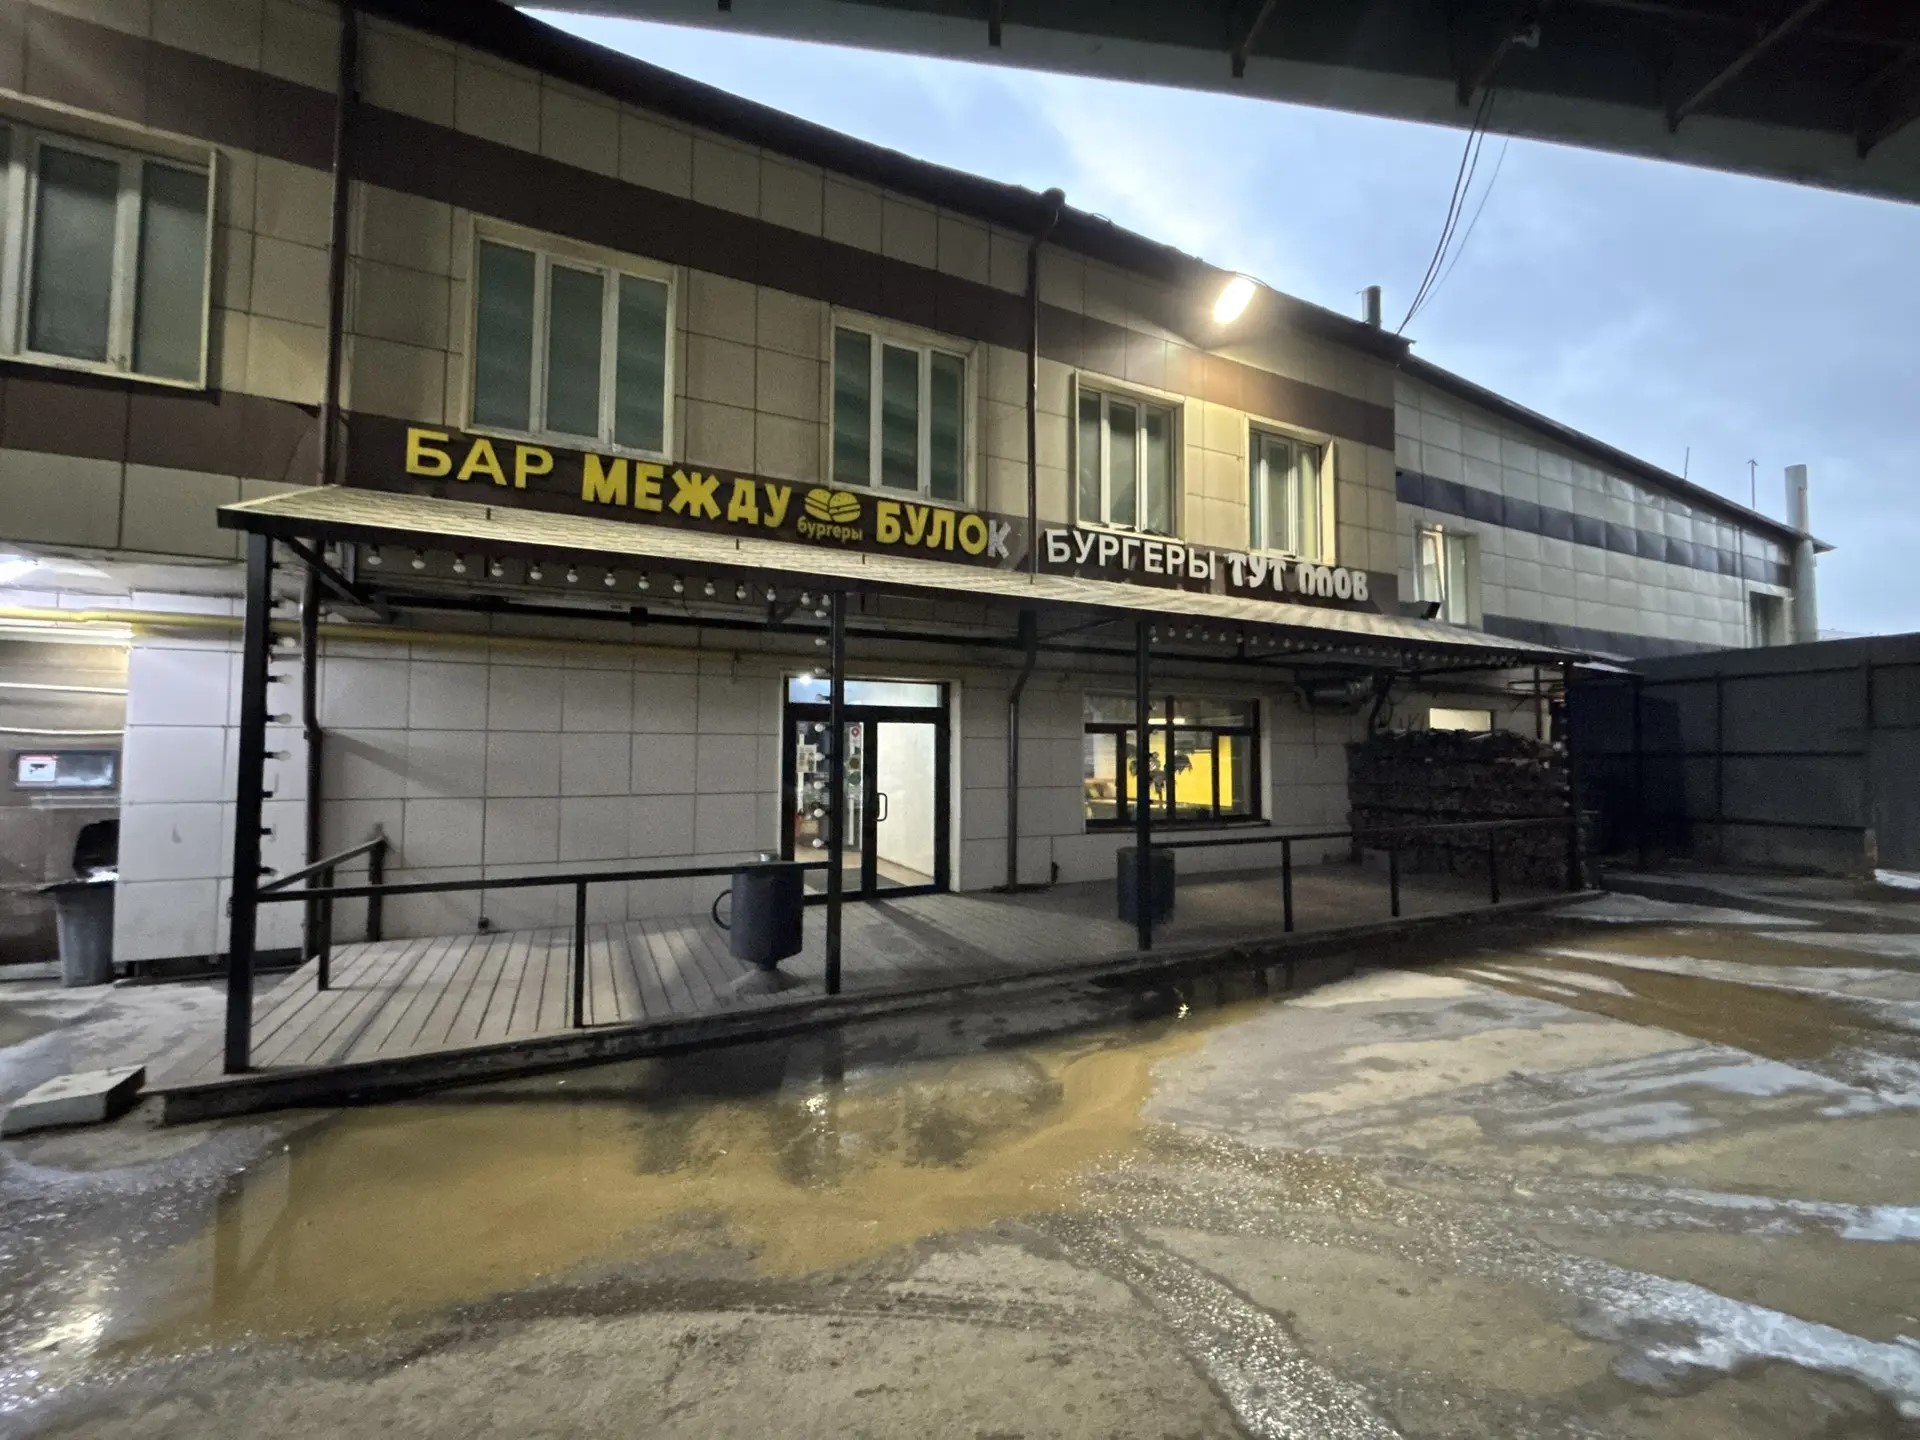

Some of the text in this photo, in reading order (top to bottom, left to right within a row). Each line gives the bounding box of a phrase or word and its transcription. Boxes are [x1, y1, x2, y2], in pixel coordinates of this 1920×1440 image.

[405, 427, 1011, 559] БАР МЕЖДУ БУЛОК
[797, 515, 864, 544] бургеры
[1045, 528, 1216, 581] БУРГЕРЫ
[1224, 552, 1287, 592] ТУТ
